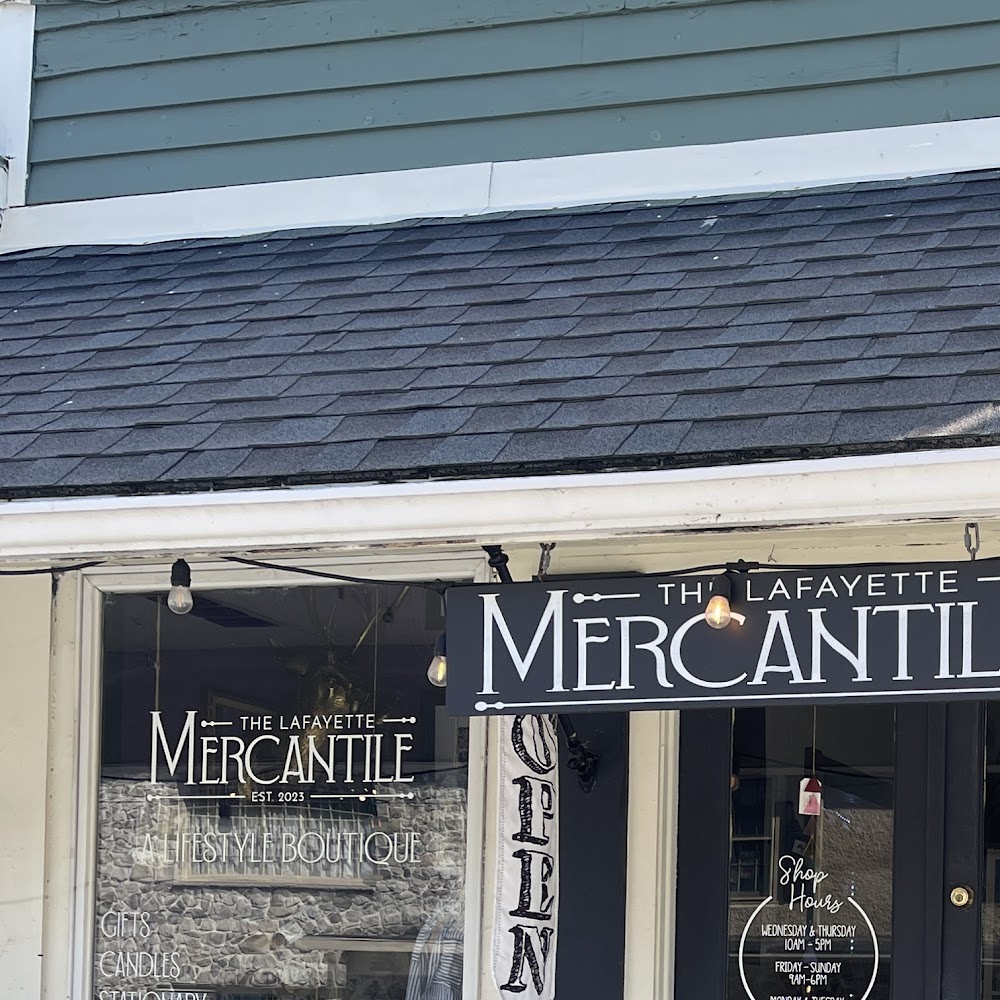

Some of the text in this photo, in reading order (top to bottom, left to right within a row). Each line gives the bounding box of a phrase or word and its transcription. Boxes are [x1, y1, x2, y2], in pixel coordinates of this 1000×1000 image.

[657, 570, 958, 606] TH LAFAYETTE
[240, 713, 376, 731] THE LAFAYETTE
[149, 710, 415, 786] MERCANTILE
[251, 791, 305, 803] EST. 2023
[142, 831, 422, 866] A LIFESTYLE BOUTIQUE
[499, 714, 558, 996] OPEN
[778, 855, 829, 893] Shop
[789, 883, 844, 913] Hours
[101, 911, 151, 938] GIFTS
[761, 924, 857, 937] WEDNESDAY & THURSDAY
[784, 938, 806, 951] 10AM
[815, 938, 832, 951] 5PM
[99, 951, 181, 978] CANDLES
[775, 961, 802, 973] FRIDAY
[810, 962, 842, 973] SUNDAY
